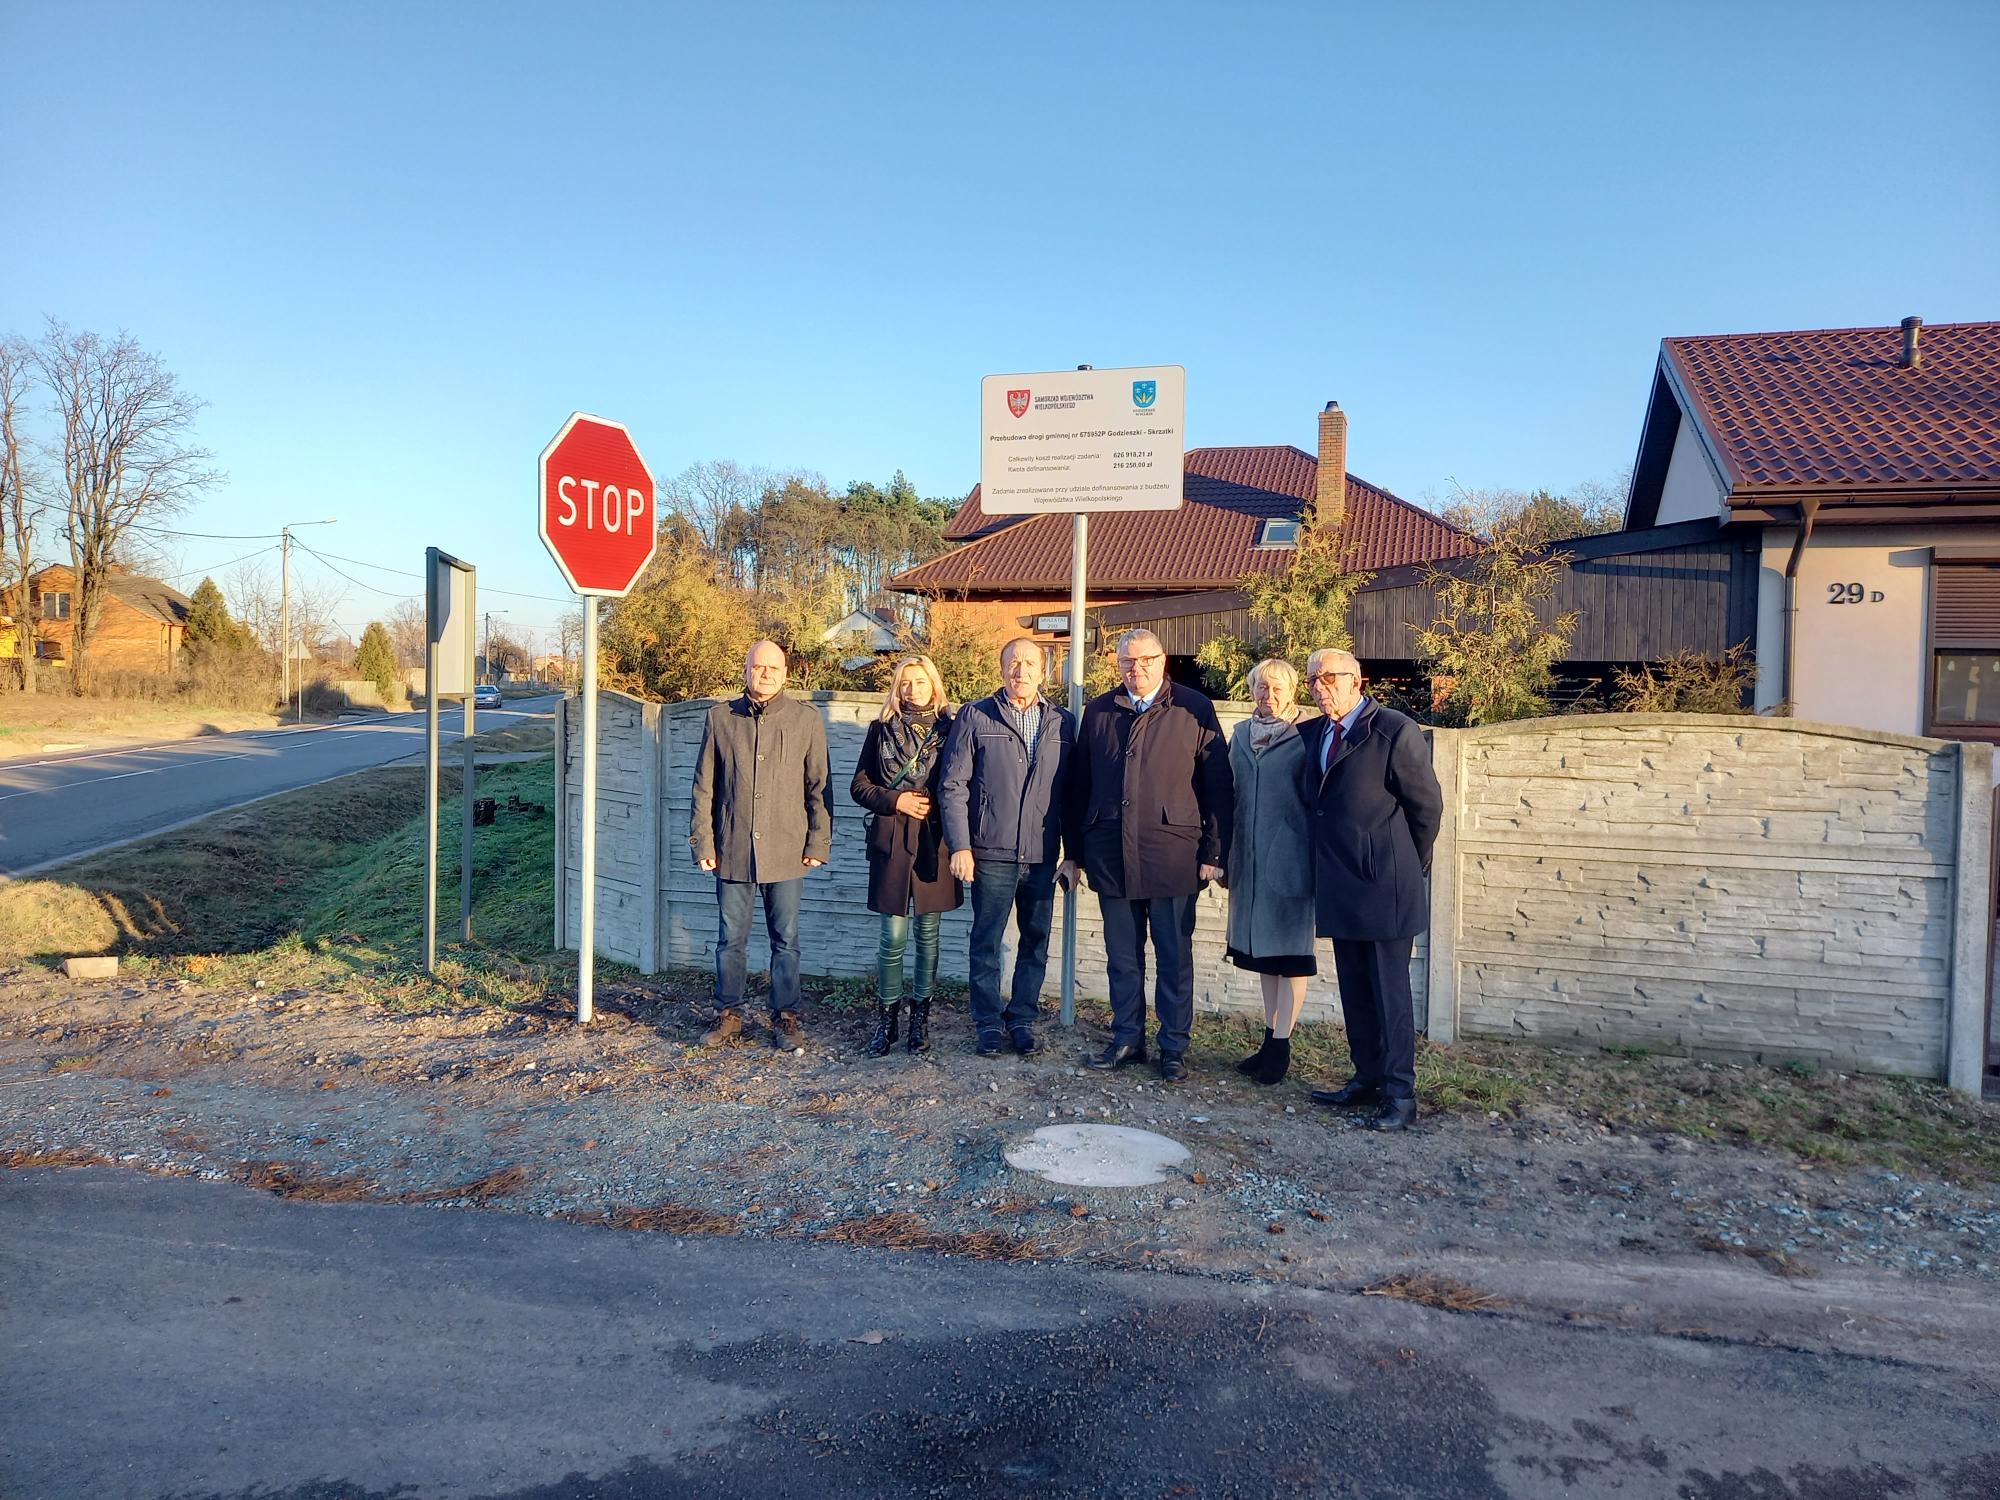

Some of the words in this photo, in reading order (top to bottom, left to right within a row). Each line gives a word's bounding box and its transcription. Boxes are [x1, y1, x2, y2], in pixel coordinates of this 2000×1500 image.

[1028, 433, 1044, 441] drogi
[1045, 432, 1070, 441] gminnej
[1107, 429, 1142, 437] Godzieszki
[557, 475, 645, 536] STOP
[1033, 496, 1073, 504] Województwa
[1074, 495, 1123, 503] Wielkopolskiego
[1826, 582, 1865, 605] 29
[1869, 590, 1885, 603] D
